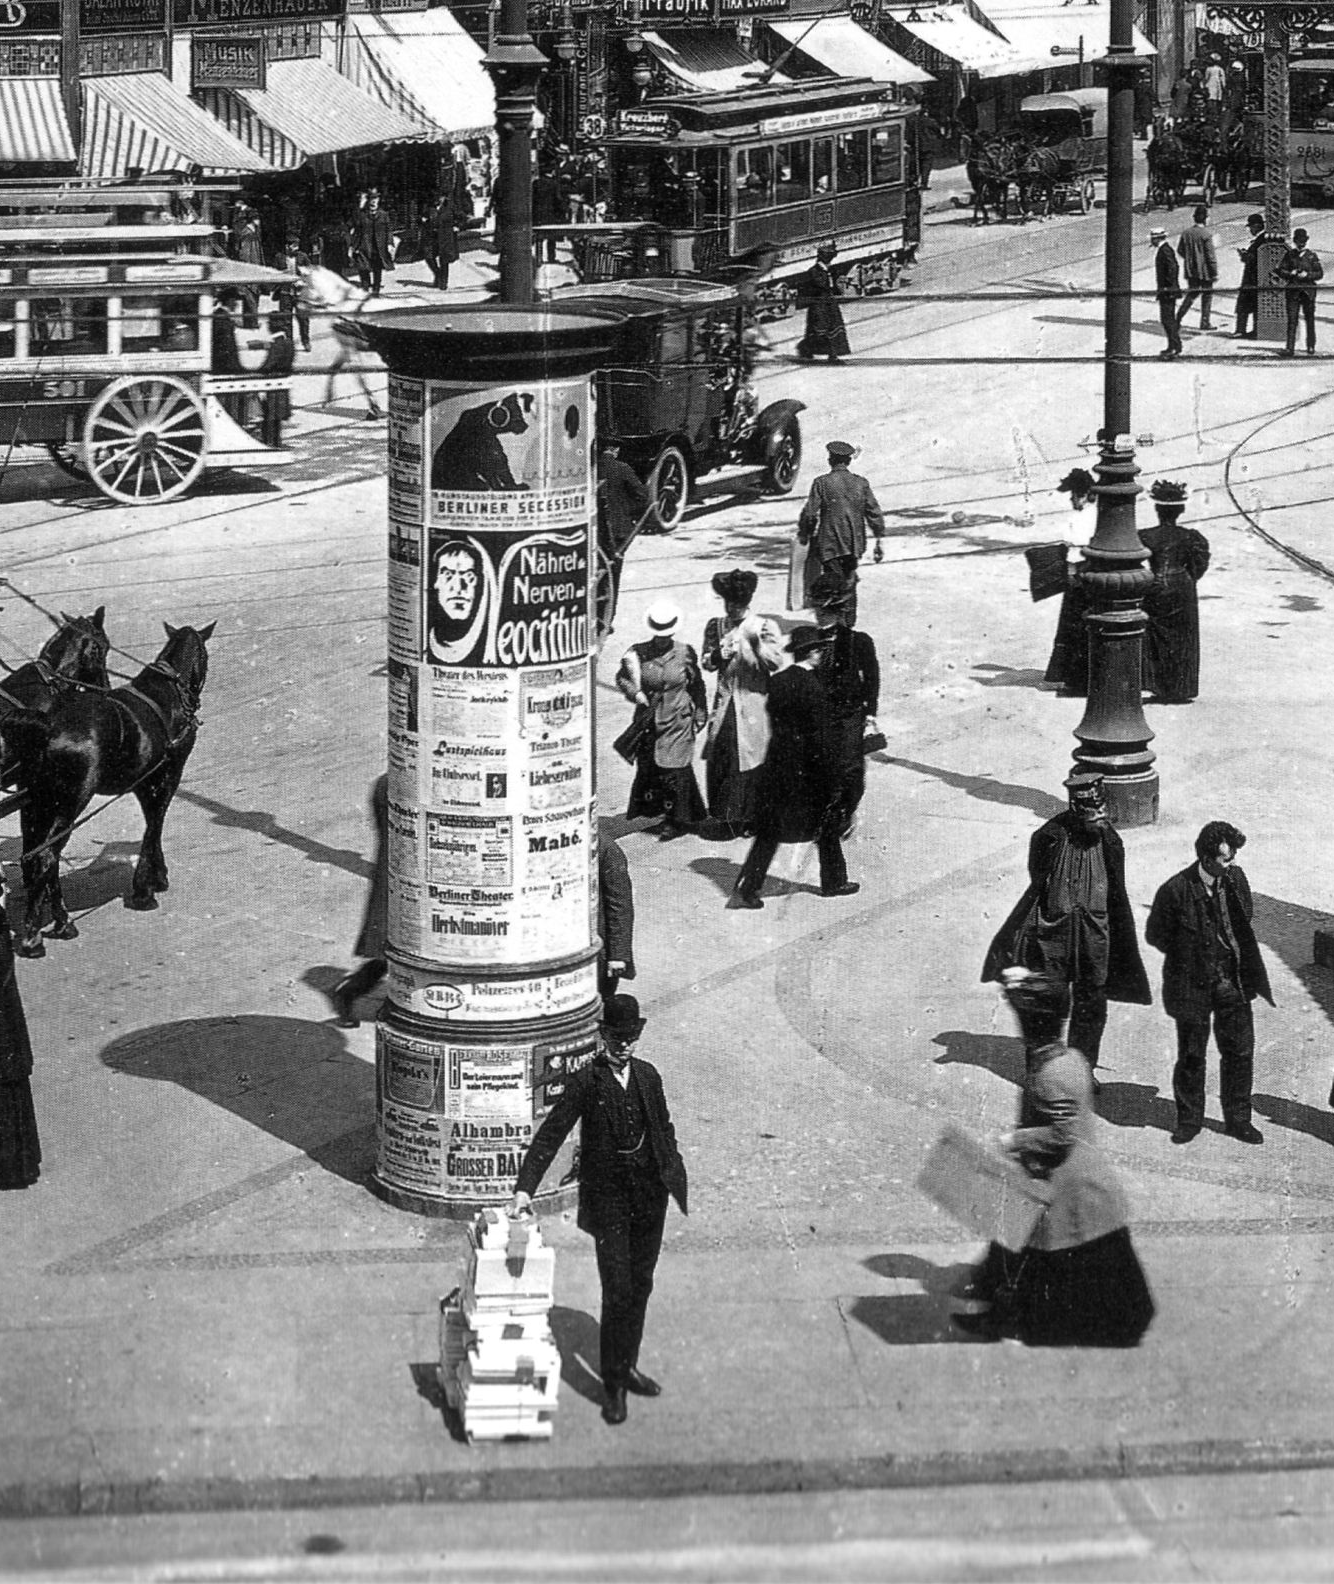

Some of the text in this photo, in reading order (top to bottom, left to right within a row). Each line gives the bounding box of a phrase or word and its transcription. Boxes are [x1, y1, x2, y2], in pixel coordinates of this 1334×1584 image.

[204, 43, 254, 63] MUSIK
[585, 117, 603, 138] 38
[437, 494, 586, 515] BERLINER SECESSION
[520, 547, 578, 576] Nähret
[513, 575, 575, 606] Nerven
[451, 1122, 532, 1139] Alhambra
[447, 1152, 494, 1177] GROSSER
